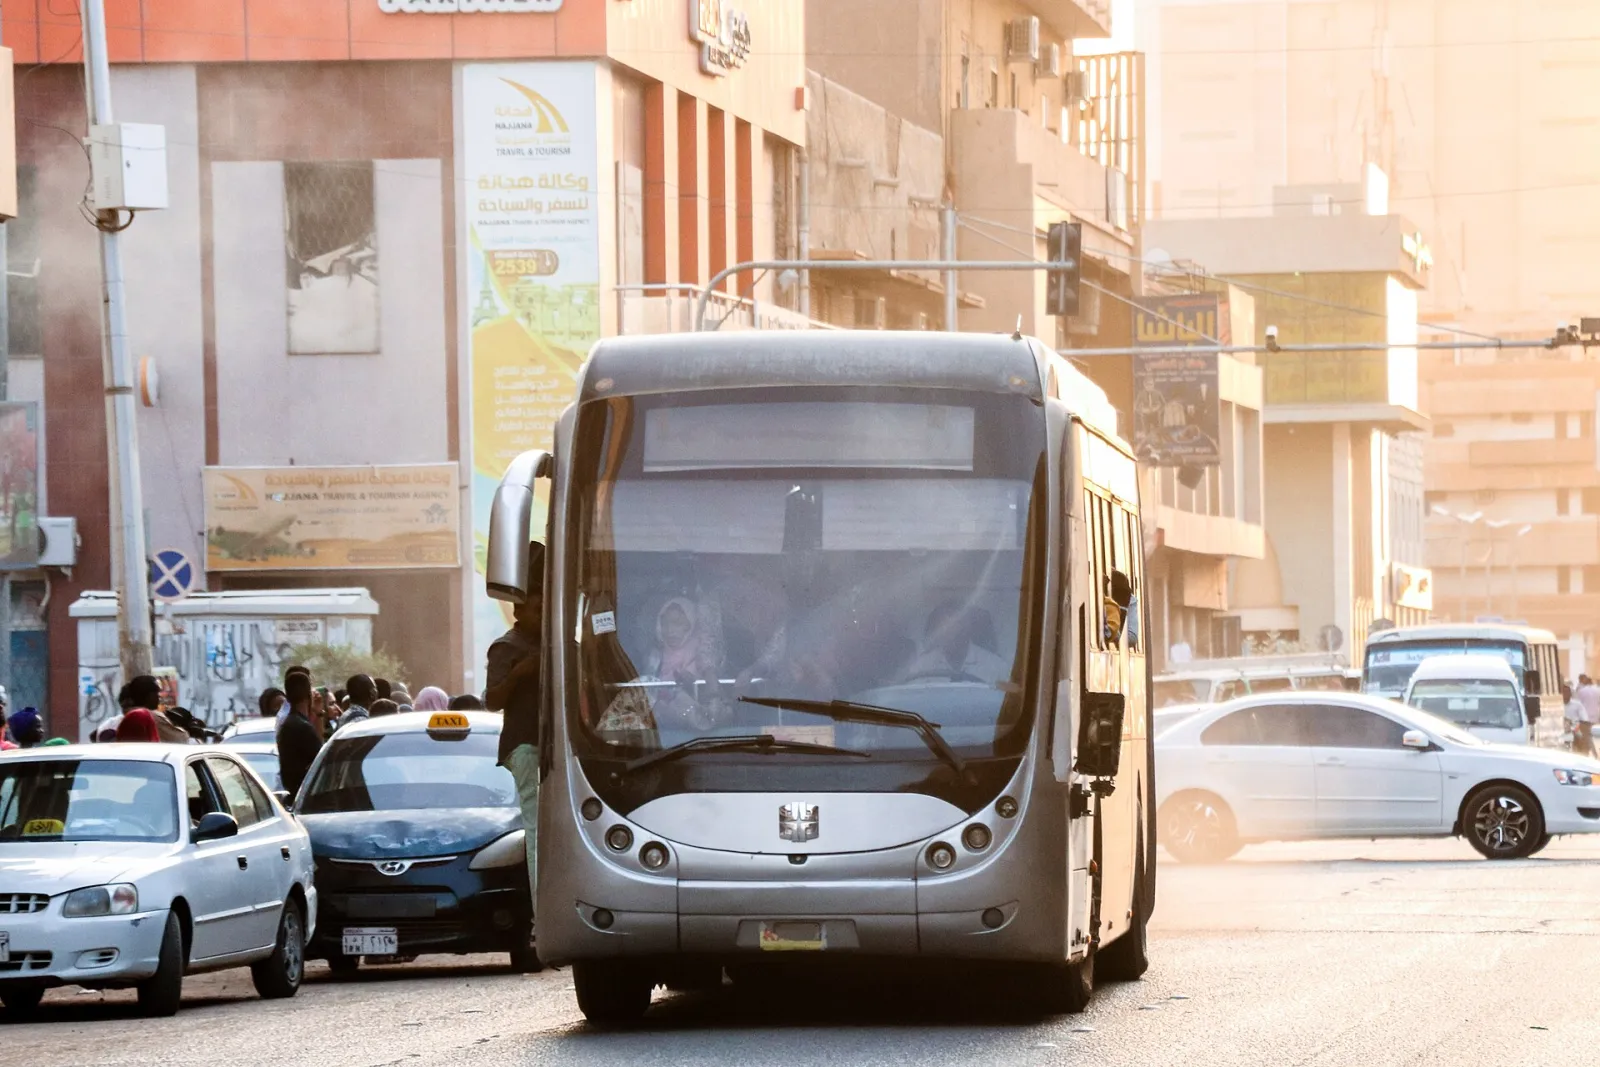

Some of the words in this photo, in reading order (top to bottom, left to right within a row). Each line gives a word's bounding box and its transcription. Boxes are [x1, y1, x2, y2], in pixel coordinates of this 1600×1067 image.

[477, 174, 534, 194] هجانة
[538, 172, 589, 192] وكالة
[478, 198, 543, 214] والسياحة
[547, 197, 589, 213] للسفر
[494, 259, 537, 275] 2539
[413, 491, 449, 500] AGENCY
[436, 717, 463, 726] TAXI
